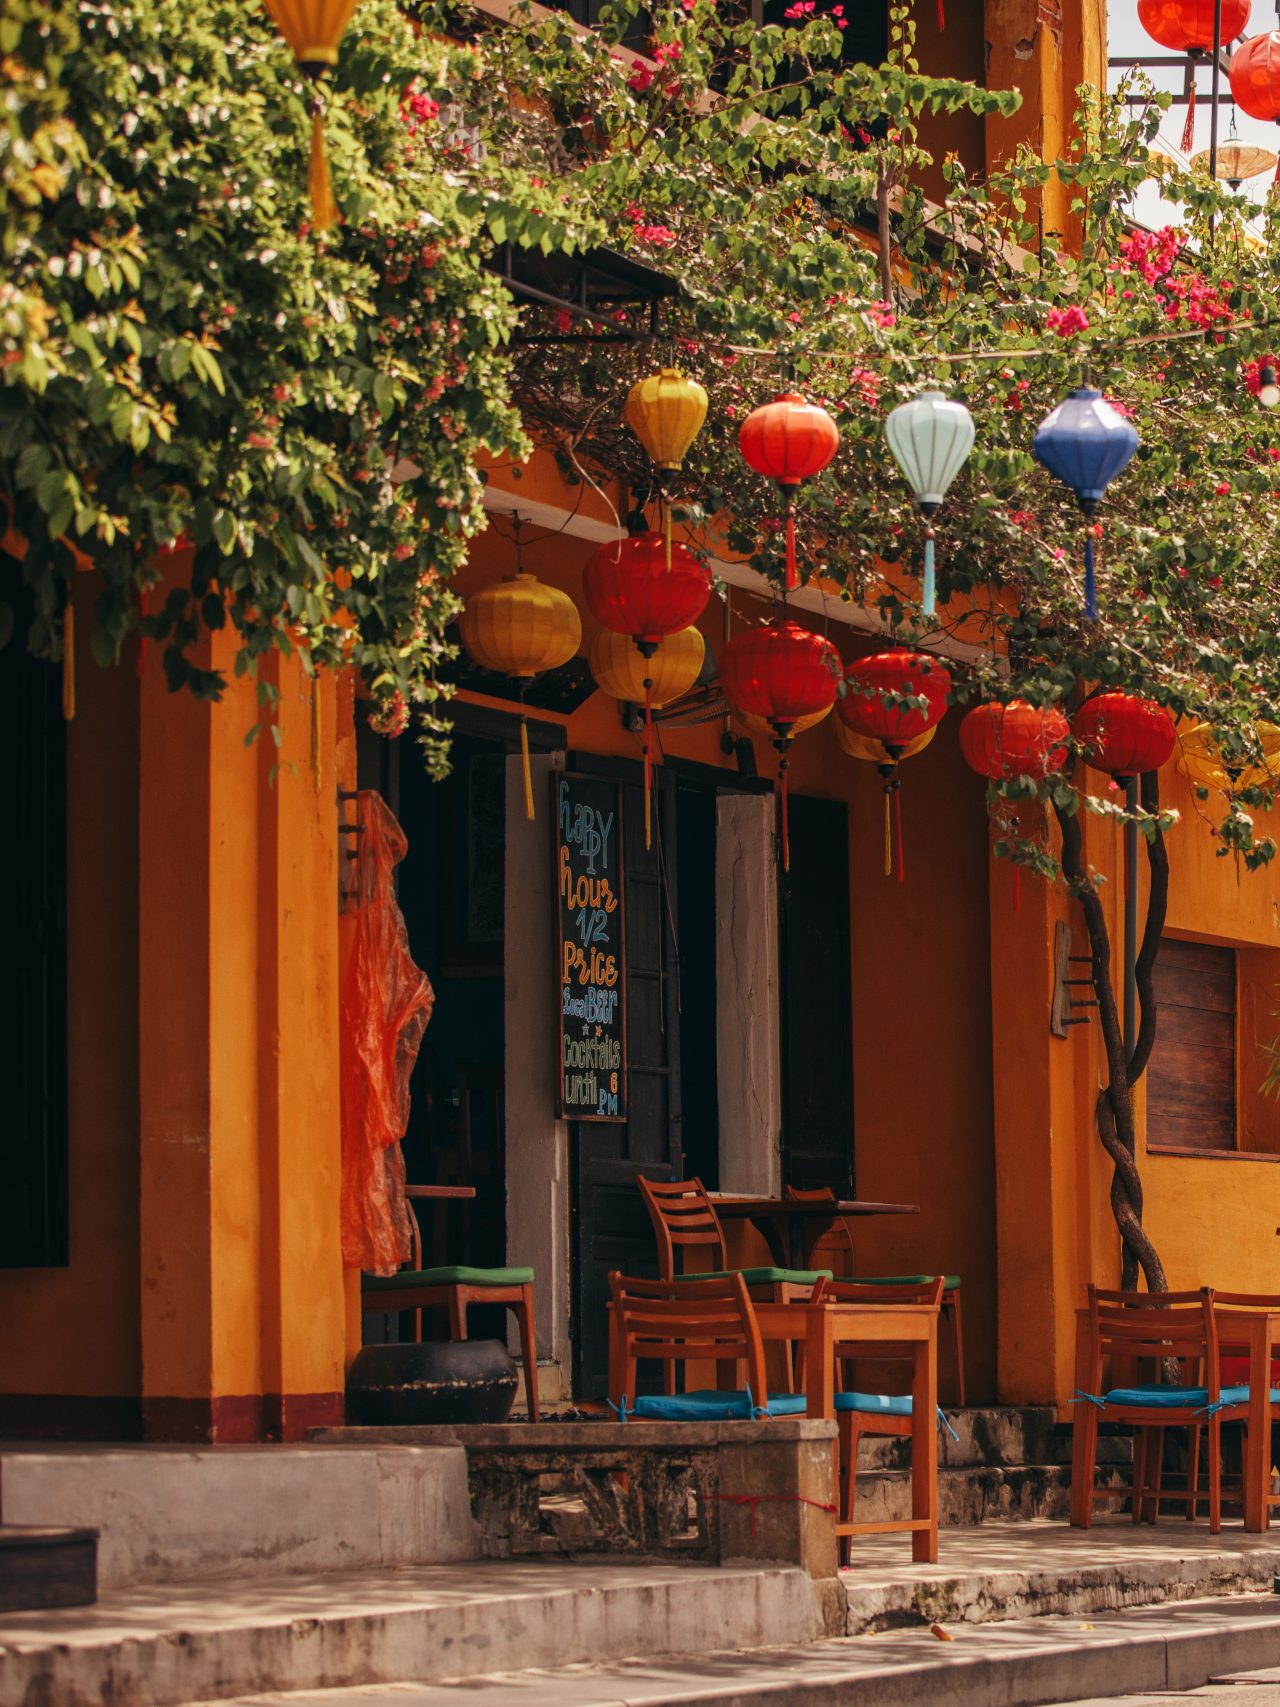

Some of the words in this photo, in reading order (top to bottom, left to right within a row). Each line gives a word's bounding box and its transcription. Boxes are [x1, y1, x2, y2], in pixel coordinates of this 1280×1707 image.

[560, 845, 618, 913] hour
[576, 907, 610, 947] 1/2
[562, 940, 619, 987] Price
[565, 1070, 598, 1105] until
[610, 1071, 618, 1094] 6
[596, 1088, 618, 1116] PM
